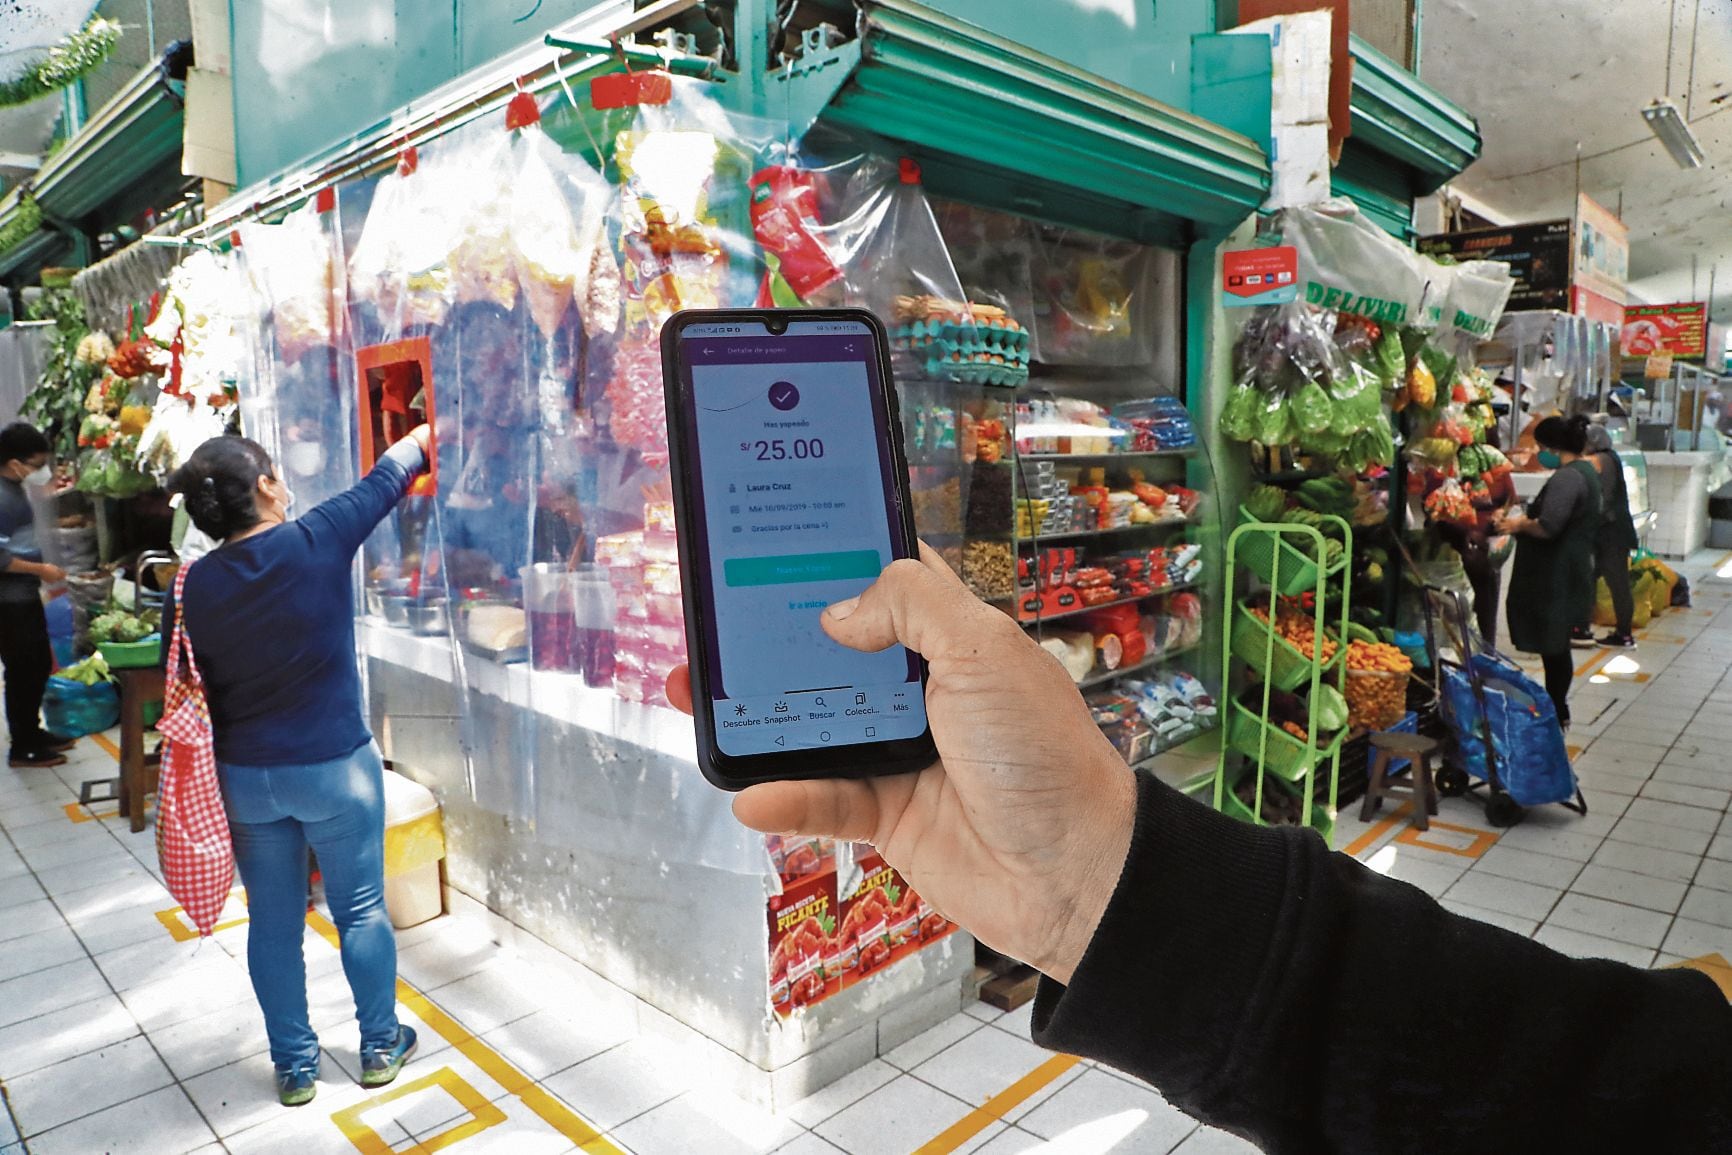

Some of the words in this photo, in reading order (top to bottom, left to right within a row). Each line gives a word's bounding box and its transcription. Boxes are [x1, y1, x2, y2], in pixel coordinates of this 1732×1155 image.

[755, 438, 824, 461] 25.00
[747, 484, 771, 492] Laura
[780, 524, 793, 532] por
[764, 715, 801, 725] Snapshot
[809, 711, 836, 720] Buscar
[723, 719, 761, 728] Descubre
[777, 904, 795, 918] NUEVA
[795, 895, 816, 909] RECETA
[777, 896, 829, 932] PICANTE
